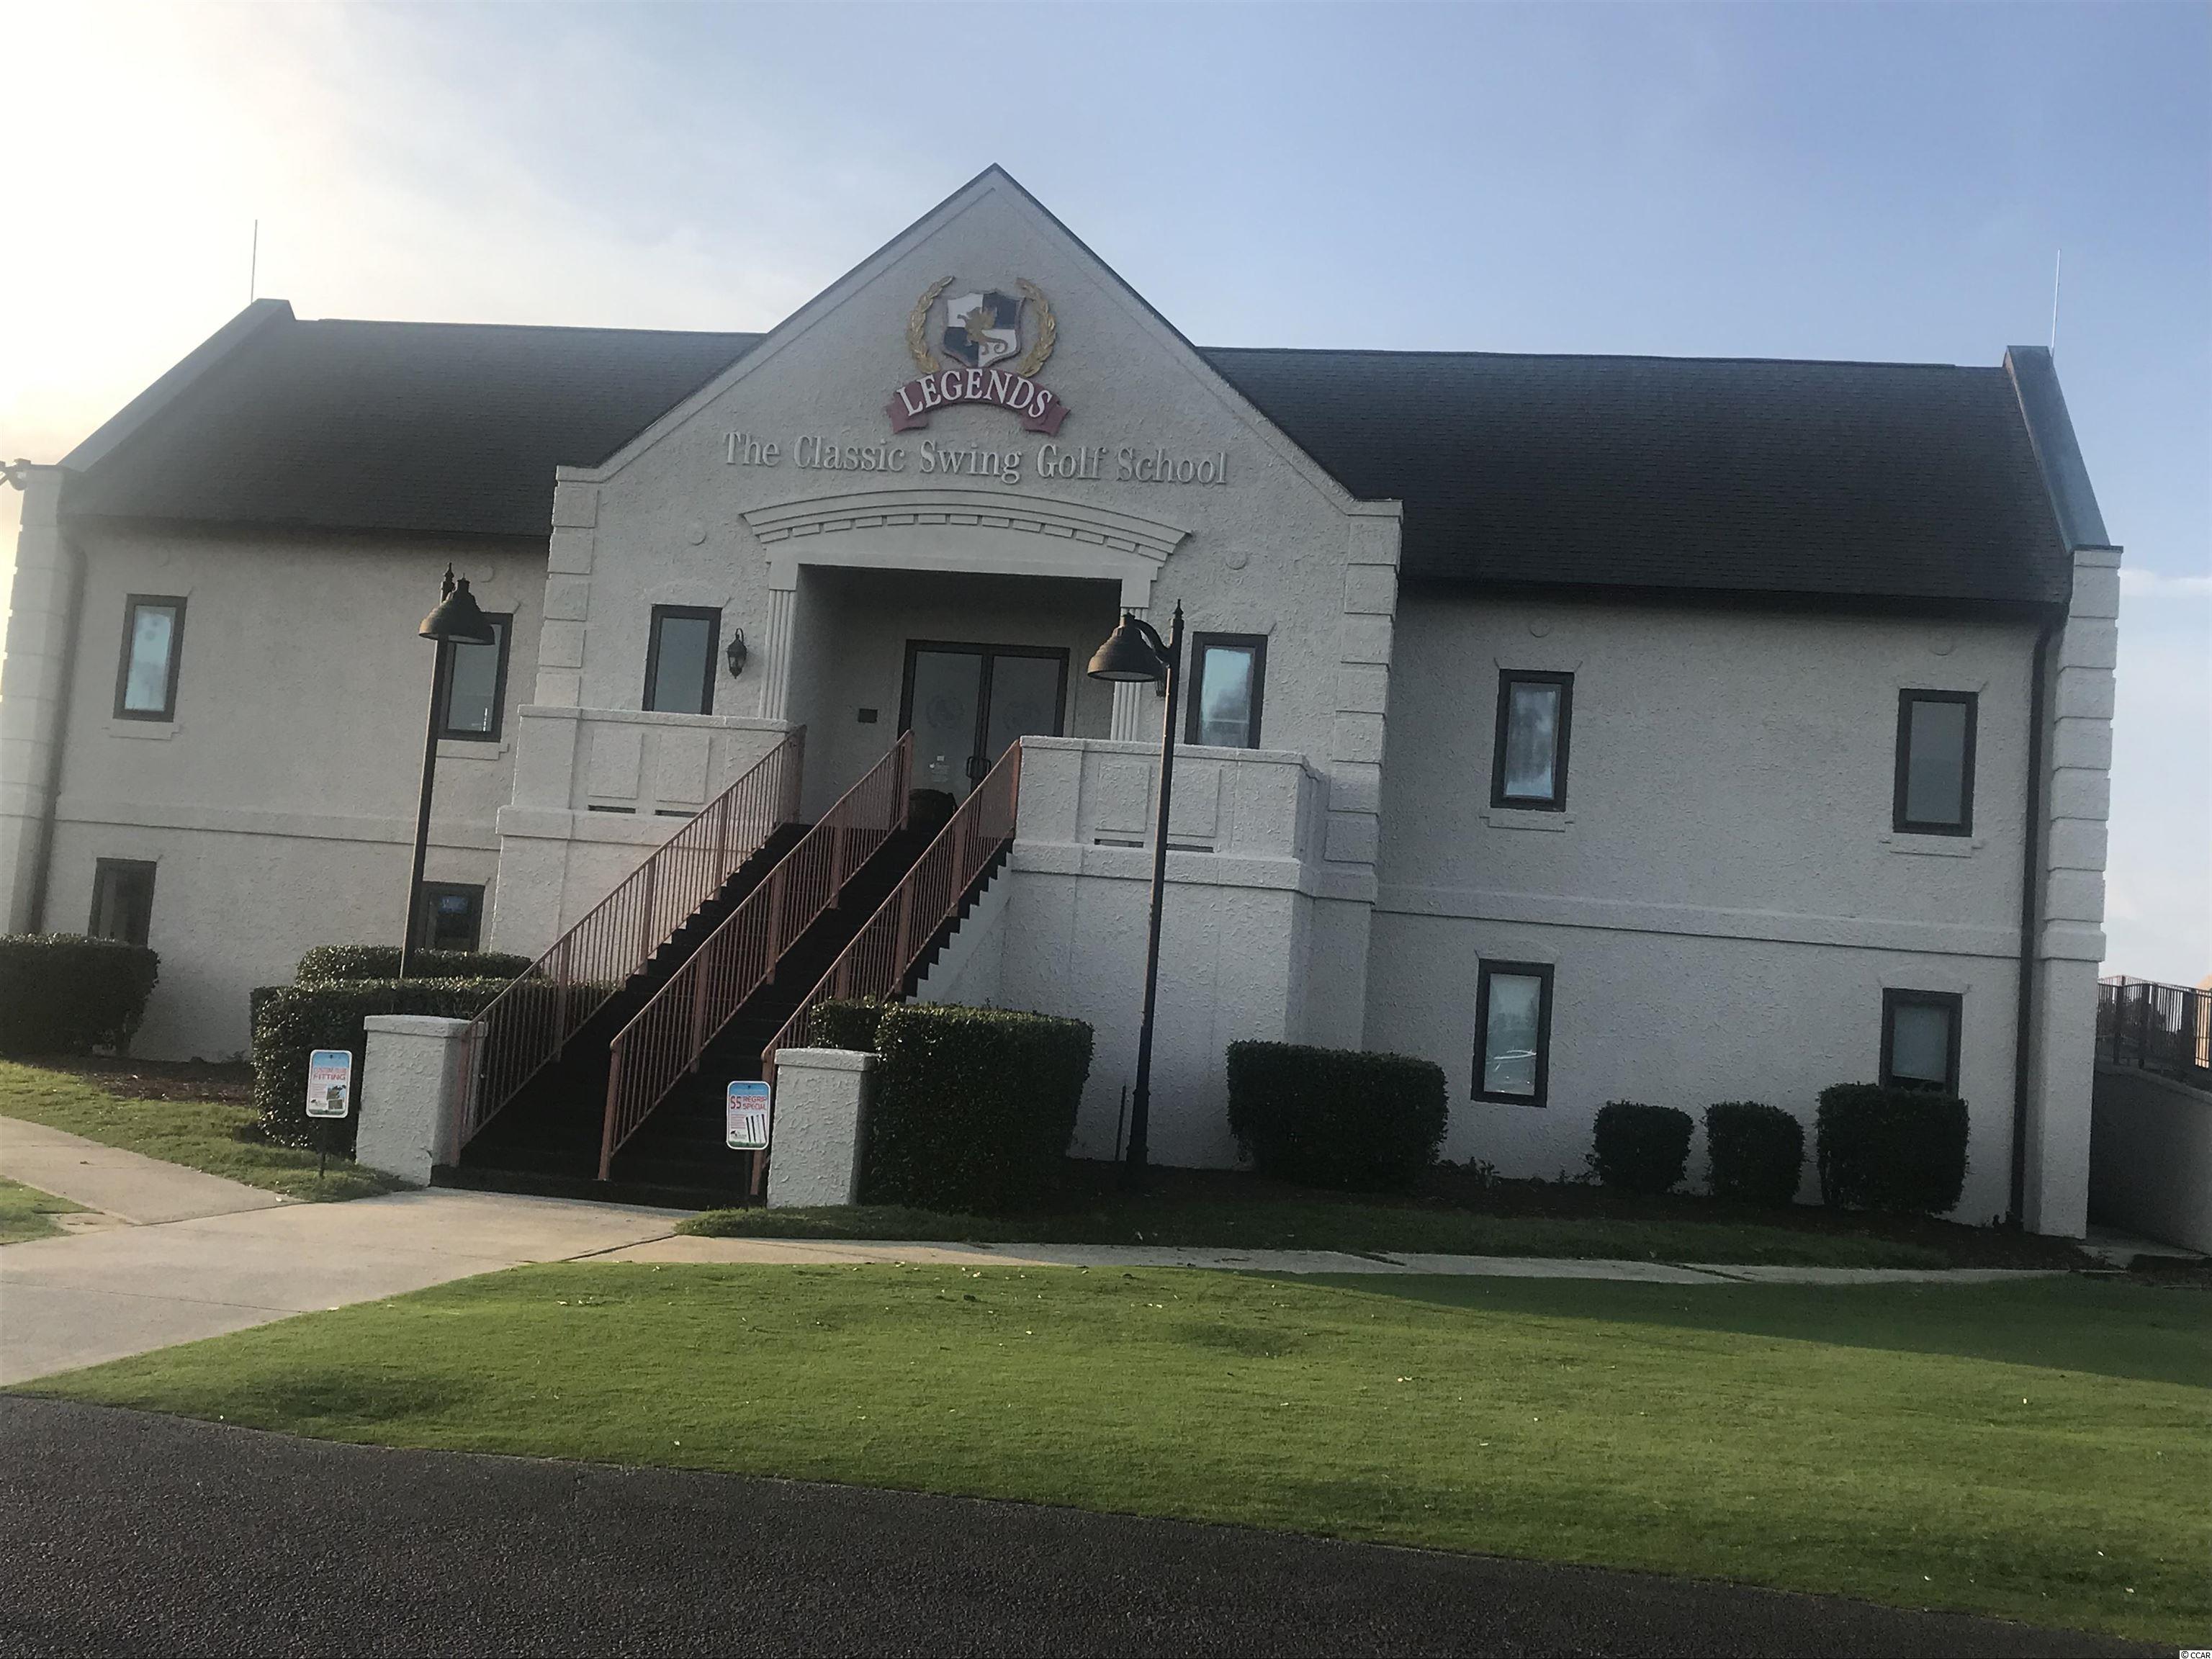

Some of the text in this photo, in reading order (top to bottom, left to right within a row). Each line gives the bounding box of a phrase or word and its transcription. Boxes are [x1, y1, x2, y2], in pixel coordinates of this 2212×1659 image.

[896, 368, 1053, 418] LEGENDS
[722, 431, 1227, 486] The Classic Swing Golf School
